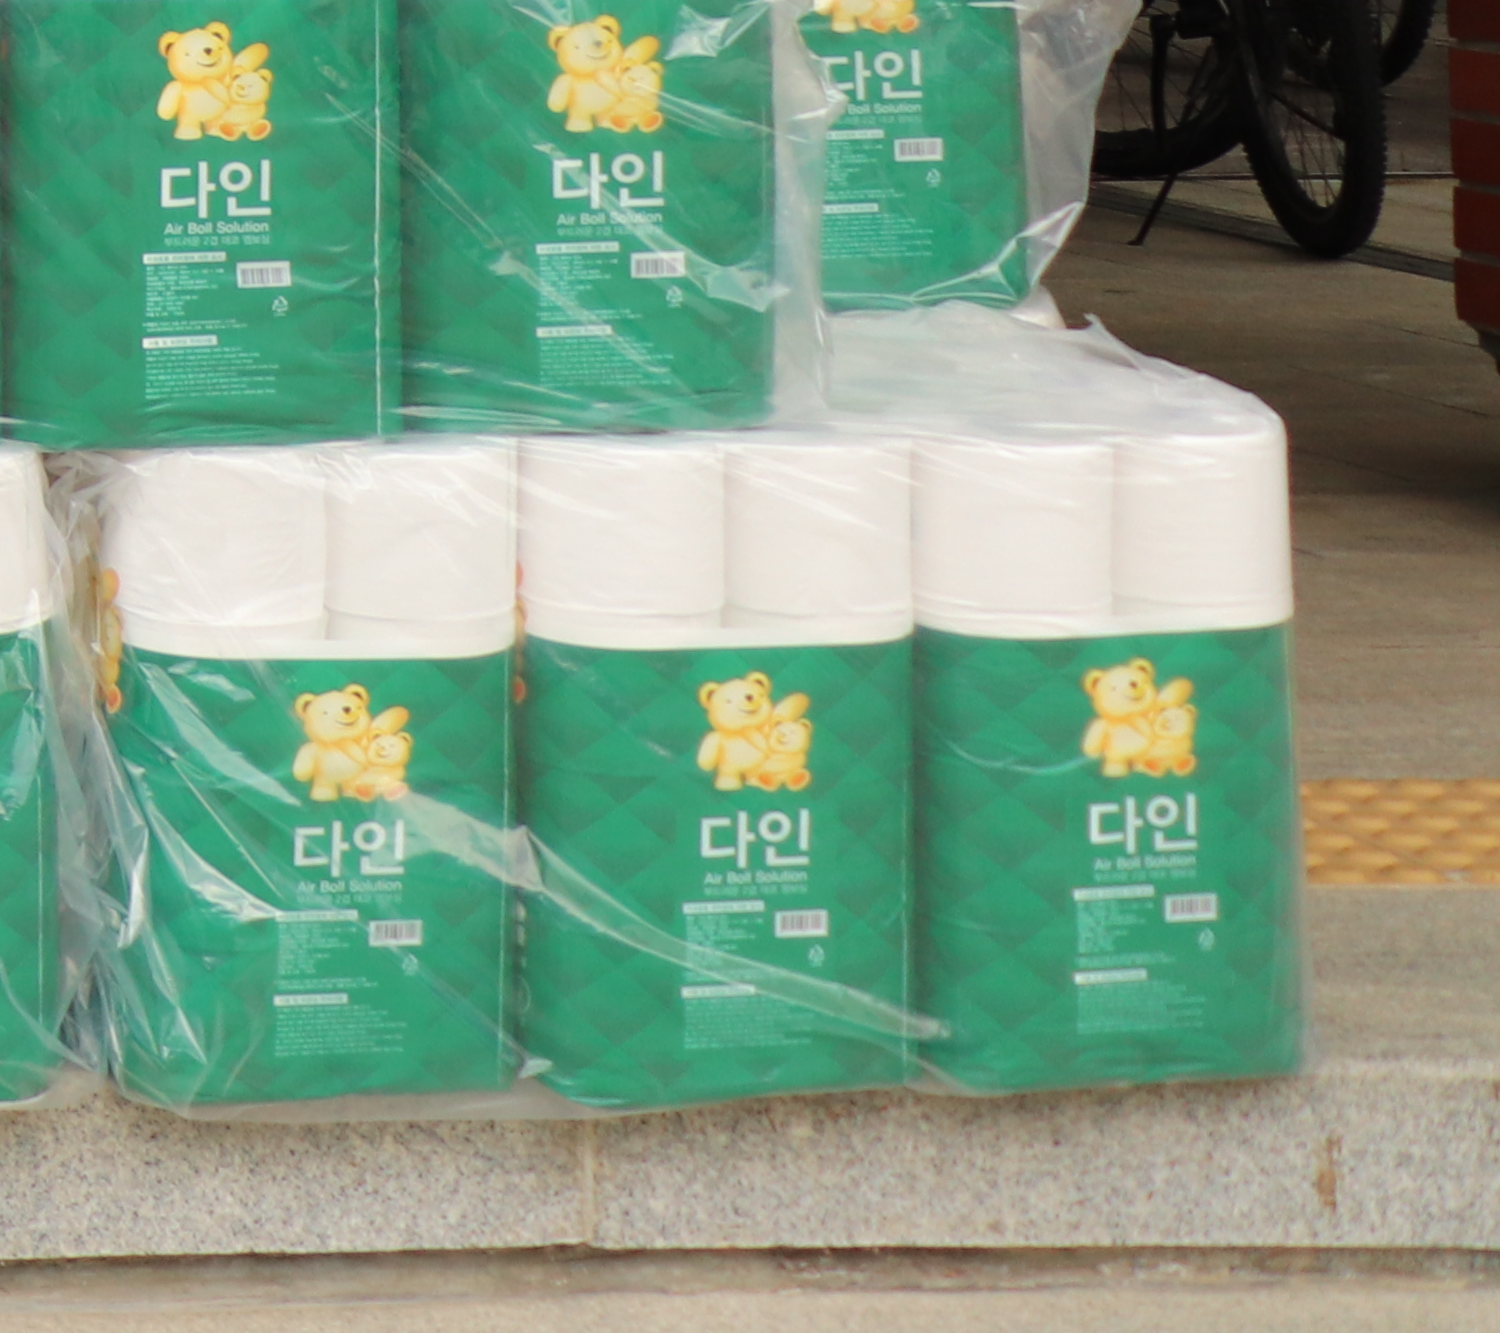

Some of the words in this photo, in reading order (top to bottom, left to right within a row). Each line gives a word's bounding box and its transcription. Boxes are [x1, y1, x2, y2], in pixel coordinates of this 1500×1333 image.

[160, 158, 273, 218] 다인
[552, 149, 665, 210] 다인
[294, 819, 407, 878] 다인
[700, 807, 811, 870] 다인
[1088, 791, 1199, 854] 다인
